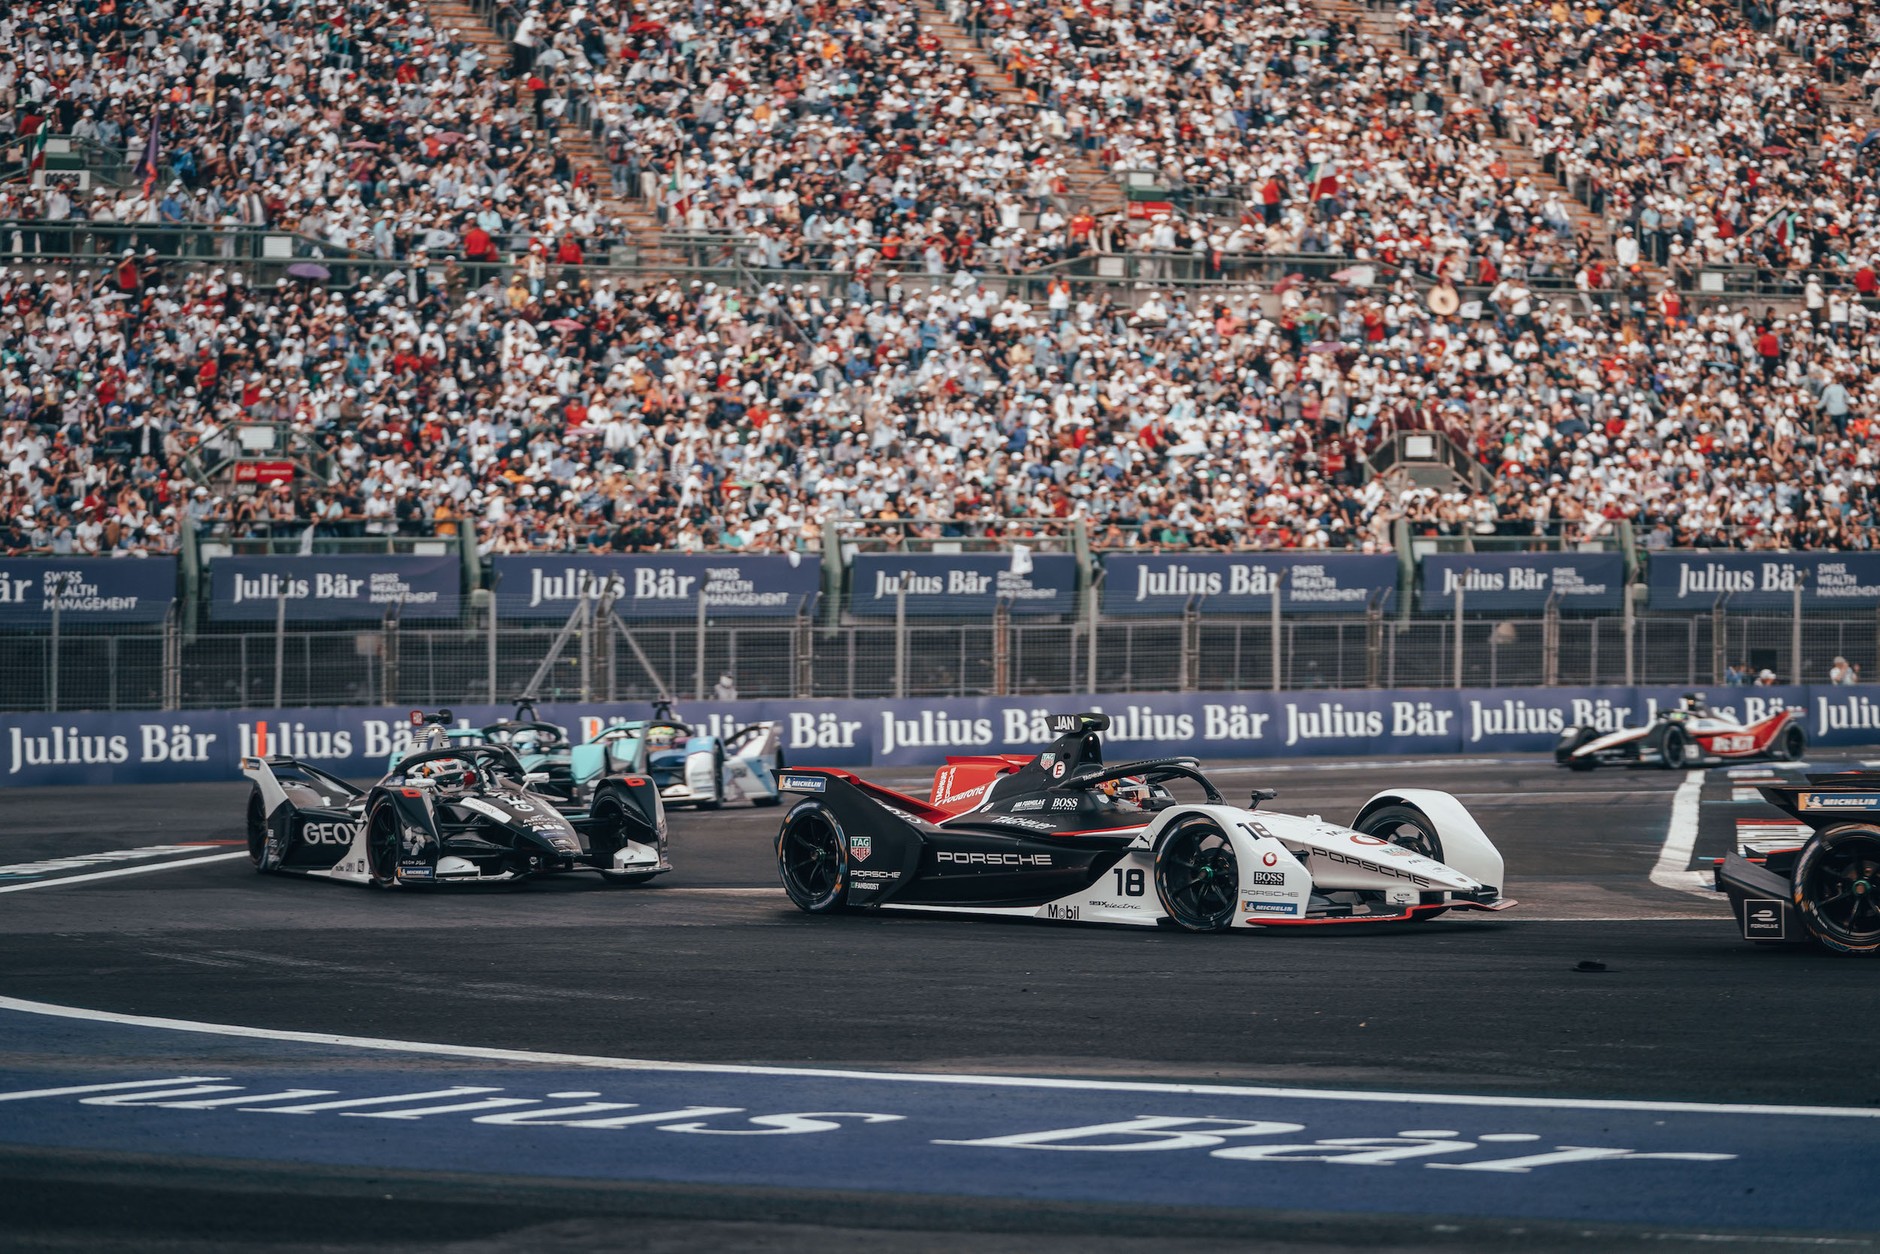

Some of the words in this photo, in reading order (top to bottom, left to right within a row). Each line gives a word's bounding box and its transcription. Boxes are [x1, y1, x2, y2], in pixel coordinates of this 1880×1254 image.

[0, 571, 32, 602] är
[43, 584, 98, 596] WALTH
[316, 573, 364, 598] Bär
[635, 568, 696, 599] Bär
[948, 570, 992, 594] Bär
[1136, 565, 1222, 601] Julius
[1508, 567, 1548, 591] Bär
[1678, 563, 1754, 598] Julius
[1761, 563, 1805, 592] Bä
[1054, 715, 1075, 730] JAN
[1203, 704, 1270, 740] Bär
[1285, 702, 1384, 746] Julius
[1391, 701, 1454, 737] Bär
[1470, 699, 1565, 743] Julius
[1571, 699, 1632, 733] Bär
[1818, 696, 1880, 737] Juli
[363, 720, 412, 758] Bä
[789, 712, 862, 749] Bär
[881, 710, 993, 755] Julius
[1002, 708, 1060, 745] Bä
[9, 726, 129, 774] Julius
[140, 724, 217, 762] Bär
[1052, 798, 1078, 807] BOSS
[852, 838, 869, 846] TAG
[1236, 822, 1273, 840] 18
[937, 851, 1052, 865] PORSCHE
[1312, 847, 1430, 888] PORSCHE
[851, 870, 901, 878] PORSCHE
[855, 882, 880, 890] FANBOOST
[1113, 868, 1145, 896] 18
[1255, 872, 1283, 881] BOSS
[1241, 889, 1299, 897] PORSCHE
[1048, 904, 1080, 919] Mobil
[1256, 904, 1294, 912] MICHELIN
[0, 1074, 908, 1136] Julius
[928, 1113, 1739, 1174] Bär
